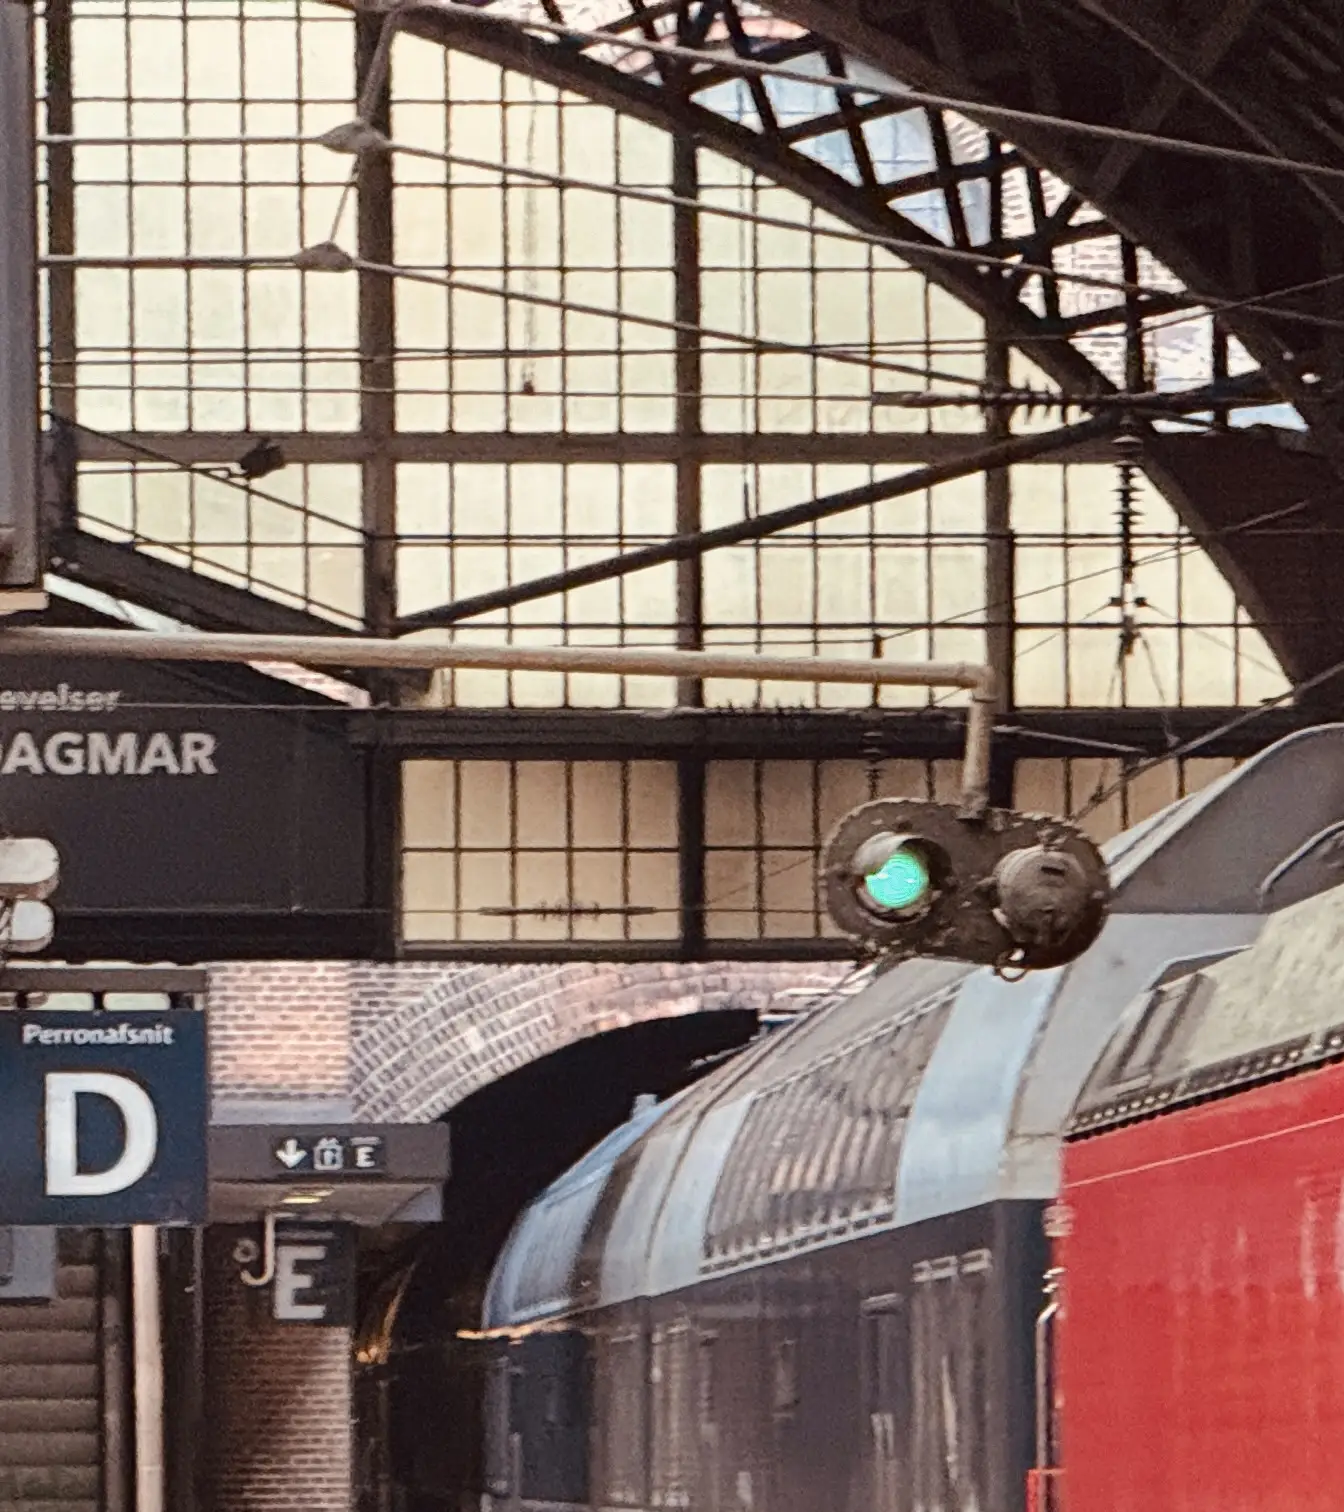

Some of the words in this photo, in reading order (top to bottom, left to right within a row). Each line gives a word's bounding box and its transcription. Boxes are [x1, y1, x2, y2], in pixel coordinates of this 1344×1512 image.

[0, 731, 218, 775] AGMAR
[22, 1023, 174, 1044] Perronafsnit
[45, 1072, 157, 1195] D
[356, 1146, 376, 1168] E
[275, 1245, 327, 1319] E
